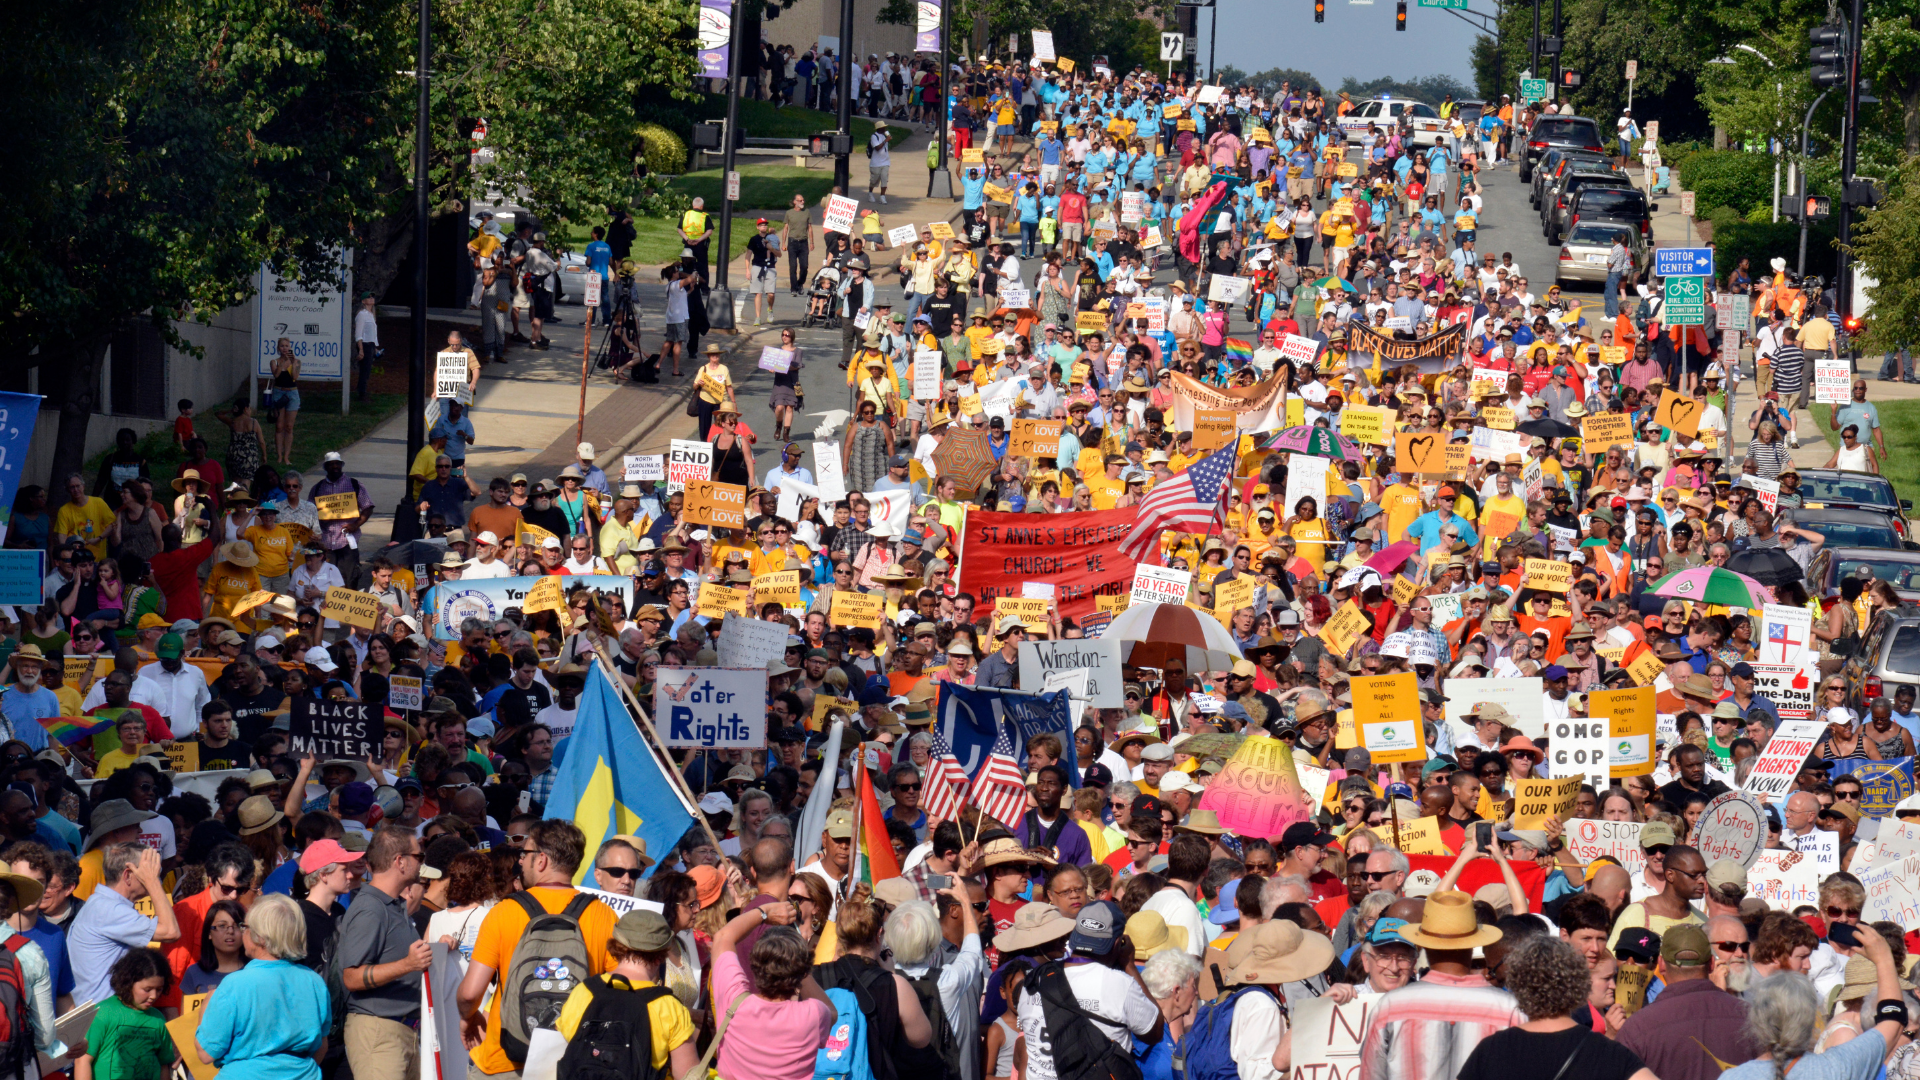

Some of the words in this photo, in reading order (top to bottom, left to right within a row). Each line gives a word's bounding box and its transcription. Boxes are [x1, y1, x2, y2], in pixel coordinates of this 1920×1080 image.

[831, 199, 856, 212] VOTING
[828, 208, 853, 220] RIGHTS
[1659, 251, 1693, 262] VISITOR
[1660, 263, 1692, 273] CENTER
[1285, 341, 1314, 355] VOTING
[1350, 329, 1382, 354] BLACK
[1385, 340, 1415, 359] LIVES
[1418, 332, 1460, 357] MATTER
[1282, 347, 1311, 361] RIGHTS
[439, 357, 466, 367] JUSTIFIED
[1816, 368, 1825, 377] 50
[1827, 369, 1849, 378] YEARS
[1817, 377, 1831, 385] AFTER
[1832, 377, 1849, 385] SELMA
[1174, 385, 1220, 408] Harnessing
[1224, 396, 1238, 408] the
[1345, 413, 1377, 422] STANDING
[1586, 416, 1623, 425] FORWARD
[1034, 426, 1059, 437] LOVE
[1195, 423, 1215, 432] Voting
[1216, 423, 1234, 431] Rights
[1587, 422, 1625, 432] TOGETHER
[1614, 433, 1632, 441] BACK!
[1032, 443, 1057, 454] LOVE
[671, 450, 709, 464] END
[671, 463, 709, 475] MYSTERY
[1525, 468, 1540, 488] END
[318, 495, 343, 504] PROTECT
[713, 491, 744, 506] LOVE
[711, 510, 743, 525] LOVE
[267, 538, 287, 546] LOVE
[980, 526, 1000, 544] ST.
[1005, 526, 1056, 546] ANNE'S
[1003, 556, 1063, 575] CHURCH
[1086, 554, 1105, 572] WE
[1529, 561, 1546, 570] OUR
[1550, 563, 1569, 573] VOTE
[535, 577, 548, 587] VOTER
[755, 576, 770, 585] OUR
[774, 574, 794, 583] VOTE
[1528, 571, 1544, 580] OUR
[1547, 573, 1569, 584] VOICE
[227, 579, 249, 590] LOVE
[530, 583, 556, 594] PROTECTION
[714, 585, 732, 595] VOTER
[754, 586, 769, 595] OUR
[773, 585, 797, 595] VOICE
[1135, 576, 1151, 589] 50
[1152, 579, 1186, 597] YEARS
[1222, 584, 1249, 596] PROTECTION
[1397, 579, 1411, 593] OUR
[332, 589, 352, 602] OUR
[354, 594, 377, 607] VOTE
[705, 590, 740, 602] PROTECTION
[849, 593, 868, 601] VOTER
[1059, 583, 1087, 605] THE
[1114, 595, 1125, 604] LET
[1133, 588, 1157, 601] AFTER
[1158, 592, 1184, 606] SELMA
[528, 596, 558, 608] SUPPRESSION
[841, 599, 875, 608] PROTECTION
[1001, 601, 1018, 610] OUR
[1022, 602, 1044, 611] VOTE
[1219, 595, 1249, 609] SUPPRESSION
[327, 600, 346, 612] OUR
[349, 605, 376, 619] VOICE
[459, 609, 478, 617] NAACP
[837, 612, 875, 622] SUPPRESSION
[1332, 610, 1353, 632] PROTECTION
[1339, 620, 1362, 643] SUPPRESSION
[1033, 642, 1108, 671] Winston-
[1603, 650, 1623, 659] VOTE
[402, 678, 421, 688] NAACP
[1369, 680, 1396, 689] VOTING
[391, 698, 410, 706] RIGHTS
[1373, 693, 1394, 702] Rights
[1610, 694, 1638, 702] VOTING
[247, 706, 270, 715] WSSU
[309, 702, 368, 720] BLACK
[1613, 707, 1634, 716] Rights
[311, 719, 366, 739] LIVES
[670, 705, 749, 746] Rights
[1556, 723, 1603, 739] OMG
[291, 735, 382, 759] MATTER!
[1767, 739, 1813, 757] VOTING
[1555, 749, 1604, 765] GOP
[1753, 757, 1800, 775] RIGHTS
[1524, 785, 1553, 798] OUR
[1558, 780, 1581, 797] VOTE
[1744, 776, 1791, 793] NOW!
[1866, 786, 1888, 795] NAACP
[1712, 791, 1738, 808] Hoops
[1520, 803, 1548, 817] OUR
[1553, 796, 1577, 815] VOICE
[1716, 808, 1754, 839] Voting
[1602, 822, 1640, 840] STOP
[1895, 824, 1913, 840] As
[1703, 835, 1742, 861] Rights
[1861, 868, 1893, 887] Hands
[1870, 880, 1891, 897] OFF
[1765, 880, 1817, 910] Rights
[1874, 895, 1893, 909] our
[1081, 918, 1104, 930] Ford
